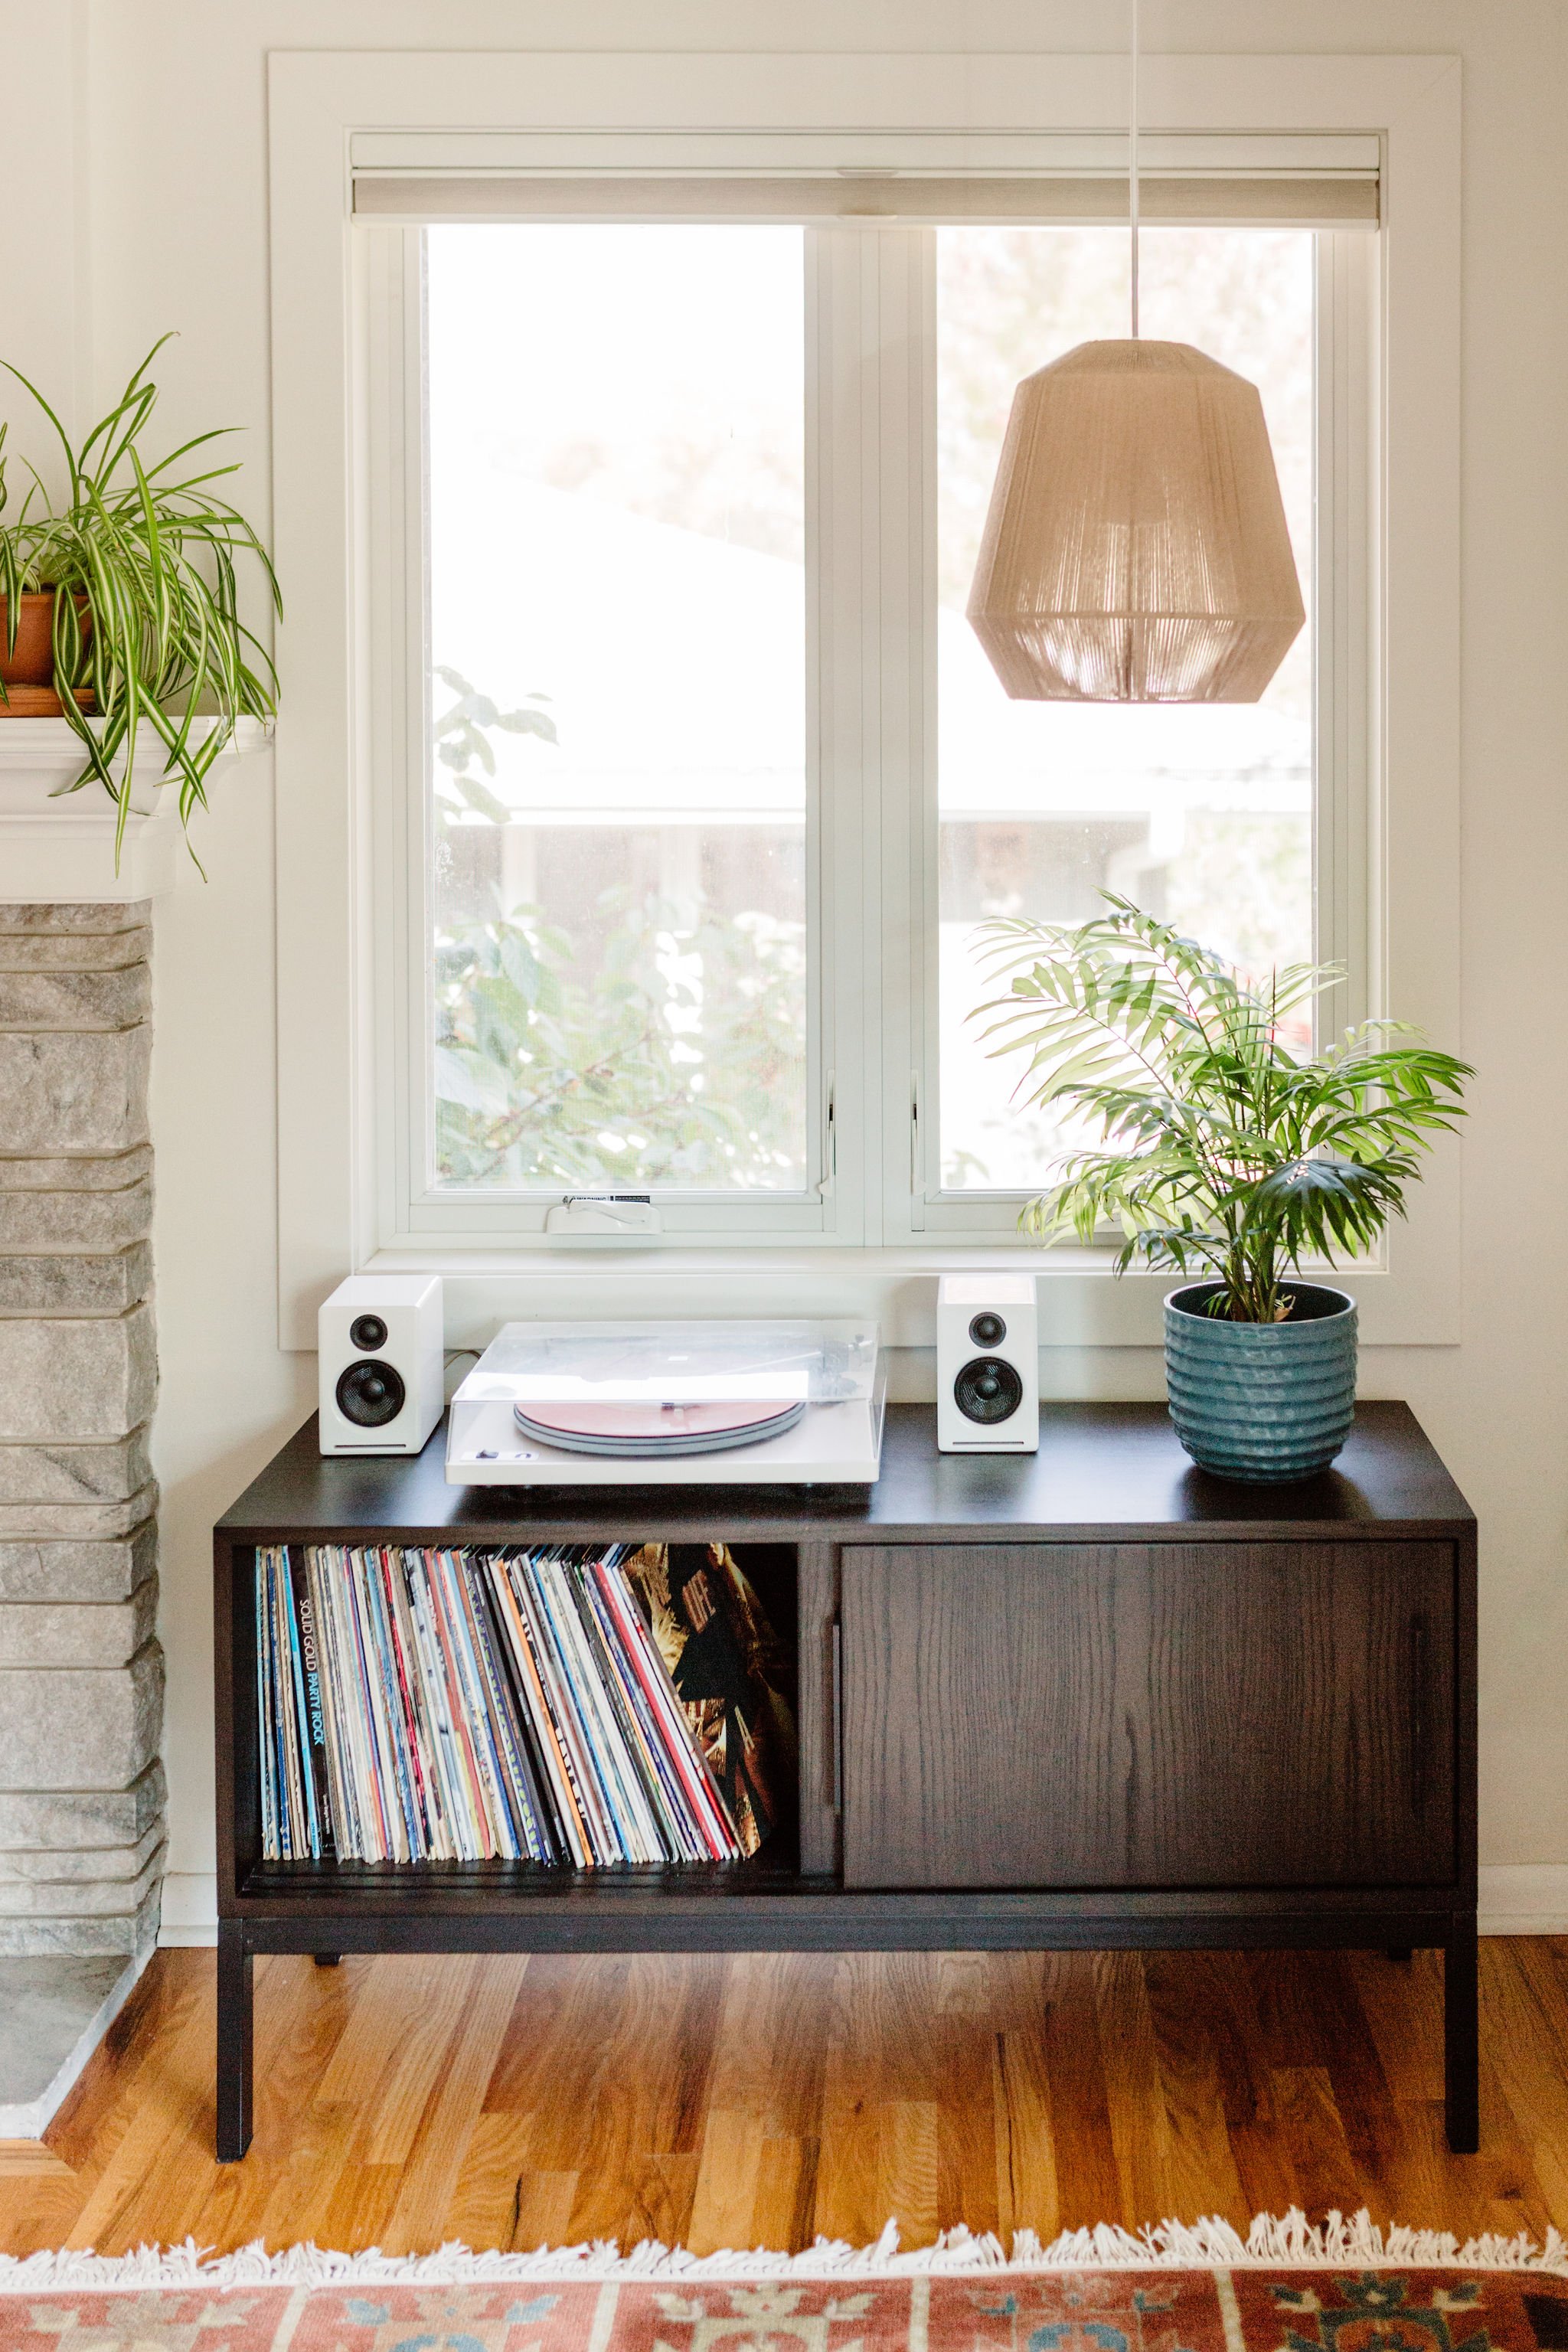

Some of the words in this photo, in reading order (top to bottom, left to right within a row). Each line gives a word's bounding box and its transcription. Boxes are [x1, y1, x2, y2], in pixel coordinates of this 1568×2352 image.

[299, 1599, 312, 1634] SOLID
[304, 1636, 317, 1671] GOLD
[307, 1672, 322, 1710] PARTY
[311, 1710, 325, 1746] ROCK
